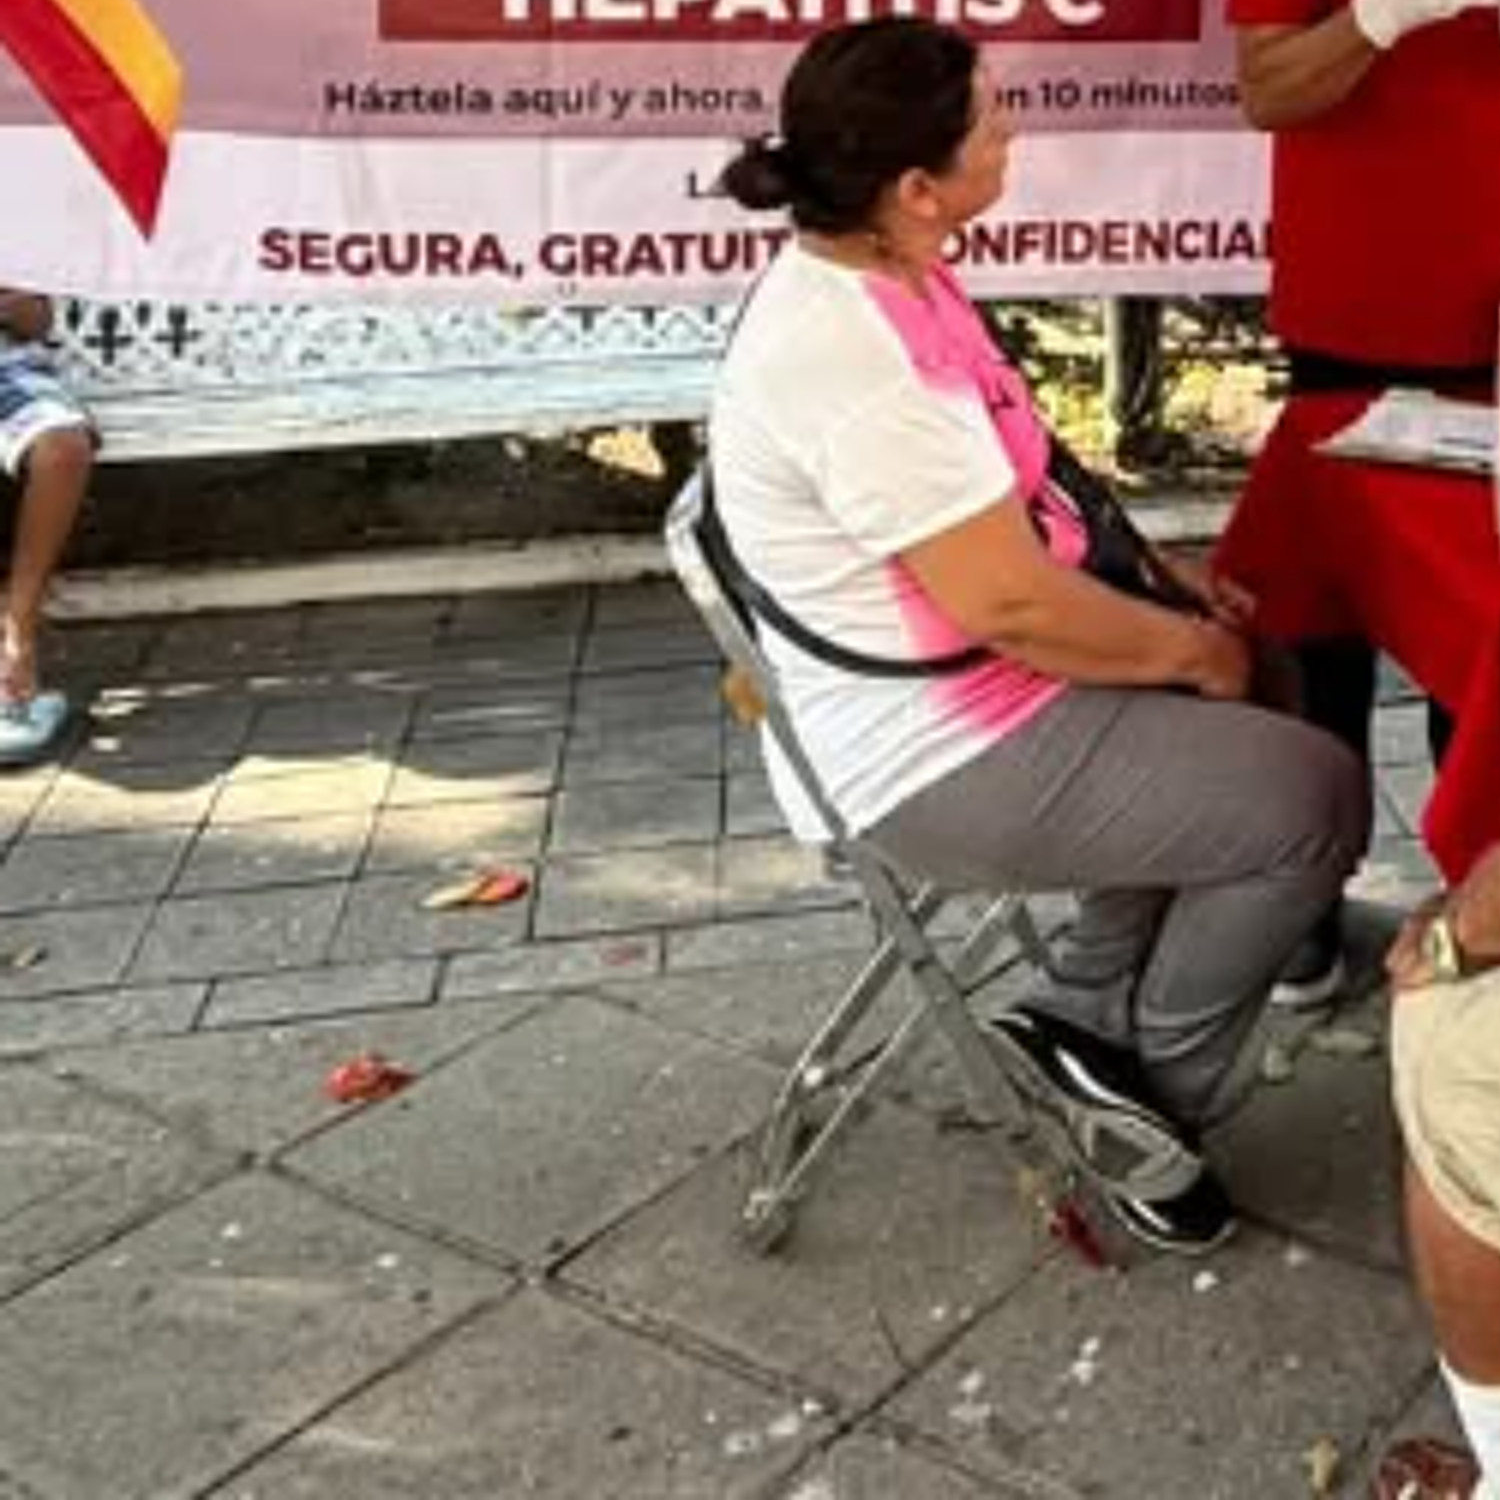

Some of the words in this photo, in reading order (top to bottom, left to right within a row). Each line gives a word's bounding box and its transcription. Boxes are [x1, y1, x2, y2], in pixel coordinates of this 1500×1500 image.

[324, 82, 493, 115] Háztela
[503, 81, 602, 119] aquí
[609, 88, 636, 121] y
[1039, 79, 1081, 108] 10
[1090, 76, 1241, 108] minutos
[258, 227, 525, 279] SEGURA,
